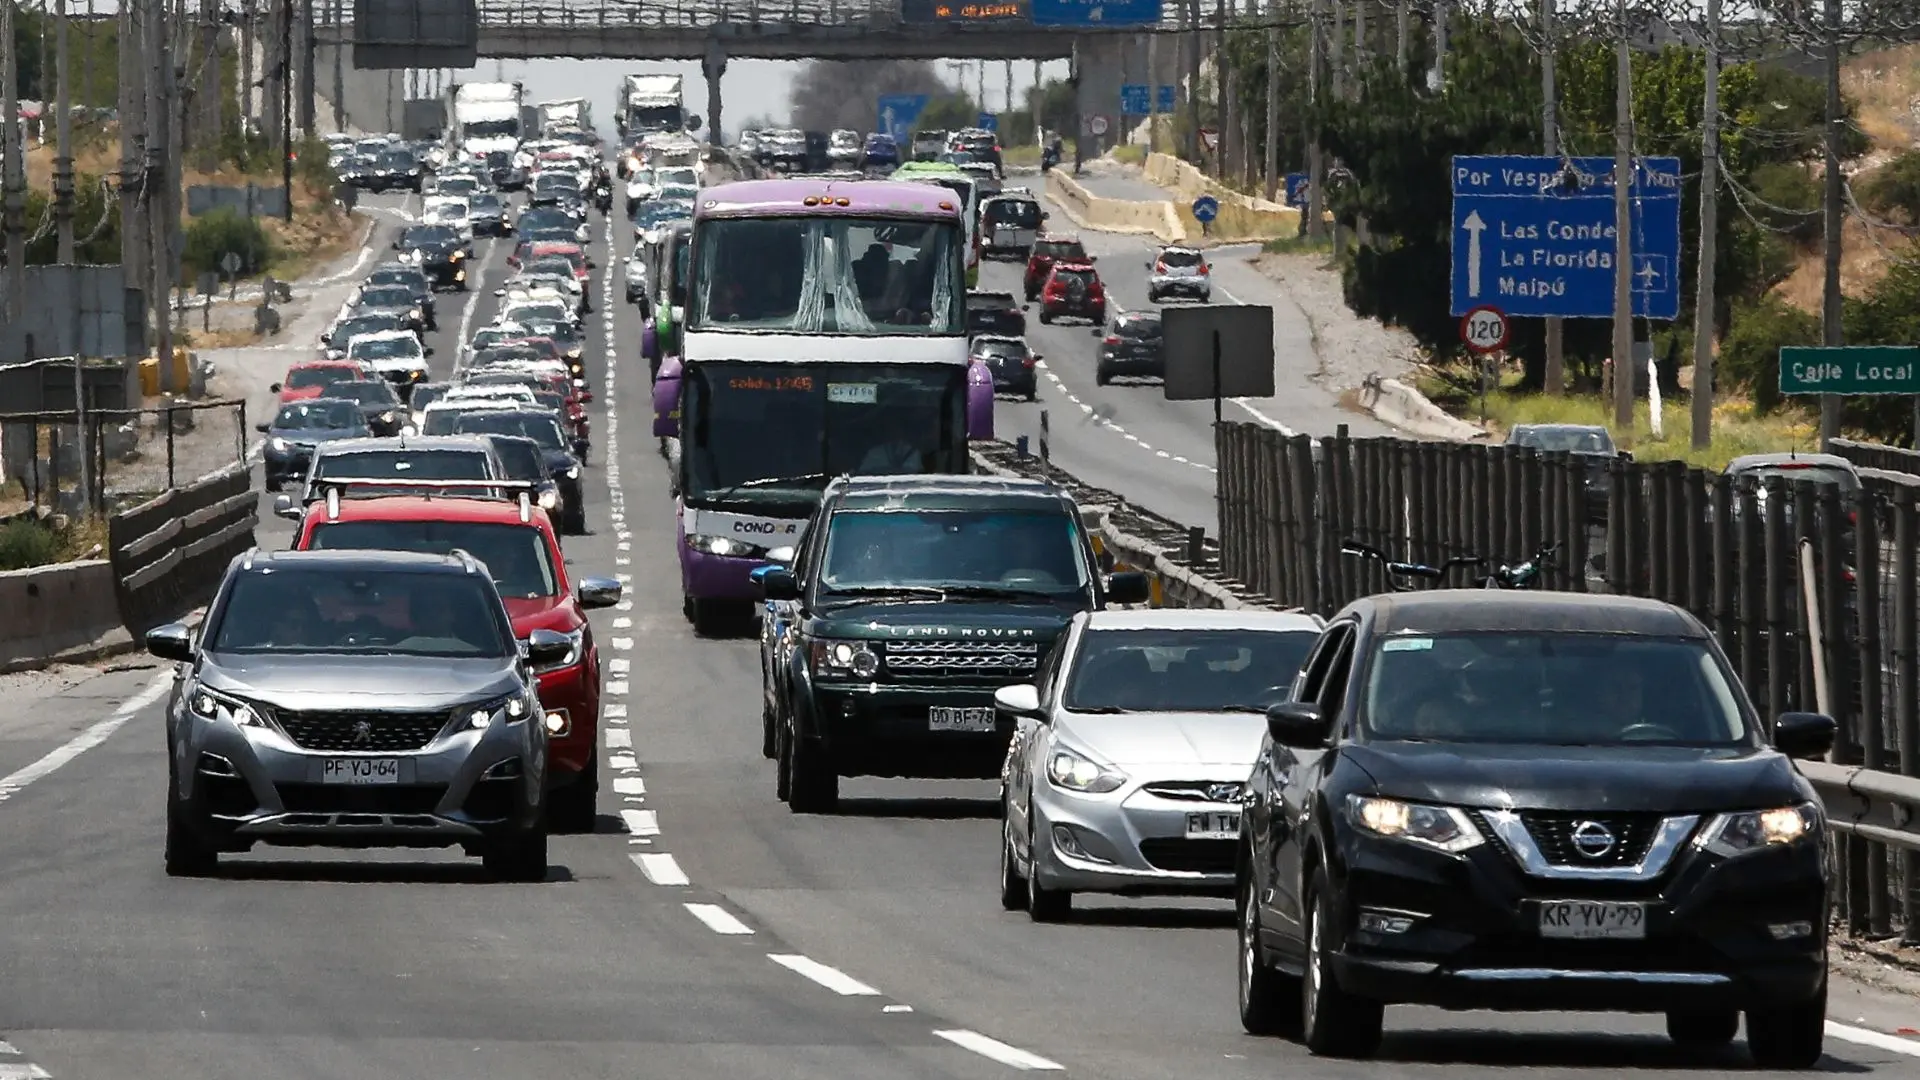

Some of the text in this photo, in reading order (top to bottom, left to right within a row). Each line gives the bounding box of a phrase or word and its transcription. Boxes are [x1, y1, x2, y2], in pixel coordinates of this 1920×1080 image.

[1457, 169, 1491, 186] Por
[1501, 220, 1618, 241] Las Conde
[1501, 249, 1614, 269] La Florida
[1499, 276, 1566, 299] Maipú
[1470, 320, 1502, 340] 120
[1855, 362, 1913, 381] Local
[733, 521, 797, 534] CONDOR
[890, 627, 1033, 638] LAND ROVER
